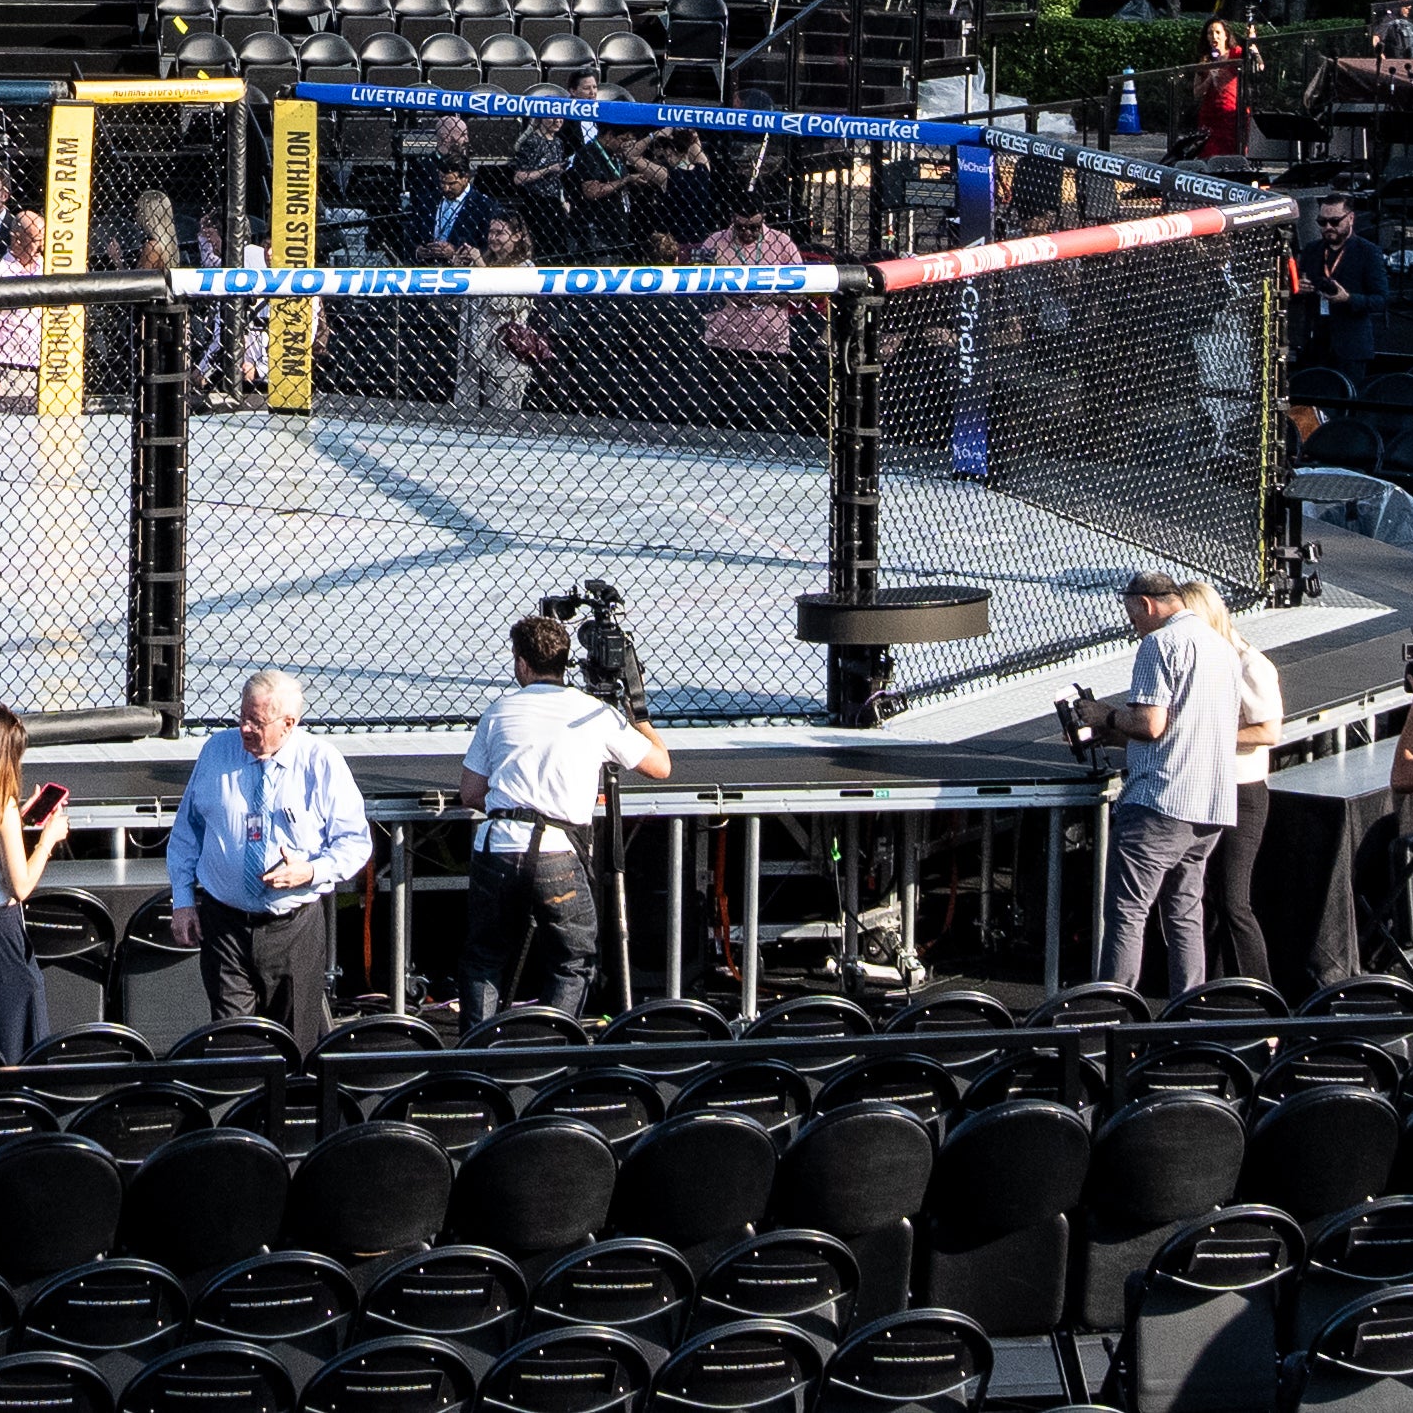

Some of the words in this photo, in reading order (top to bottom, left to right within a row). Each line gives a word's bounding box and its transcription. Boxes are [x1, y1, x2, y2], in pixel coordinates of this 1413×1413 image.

[351, 87, 436, 107] LIVETRADE
[441, 94, 463, 108] ON
[494, 94, 599, 119] Polymarket
[657, 107, 748, 128] LIVETRADE
[752, 115, 775, 129] ON
[807, 115, 920, 140] Polymarket
[55, 137, 79, 182] RAM
[286, 131, 311, 215] NOTHING
[1127, 163, 1163, 185] GRILLS
[52, 229, 74, 274] OPS
[285, 220, 309, 269] STOP
[196, 268, 326, 295] TOYO
[334, 268, 472, 295] TIRES
[537, 267, 664, 294] TOYO
[671, 265, 808, 294] TIRES
[281, 330, 307, 378] RAM
